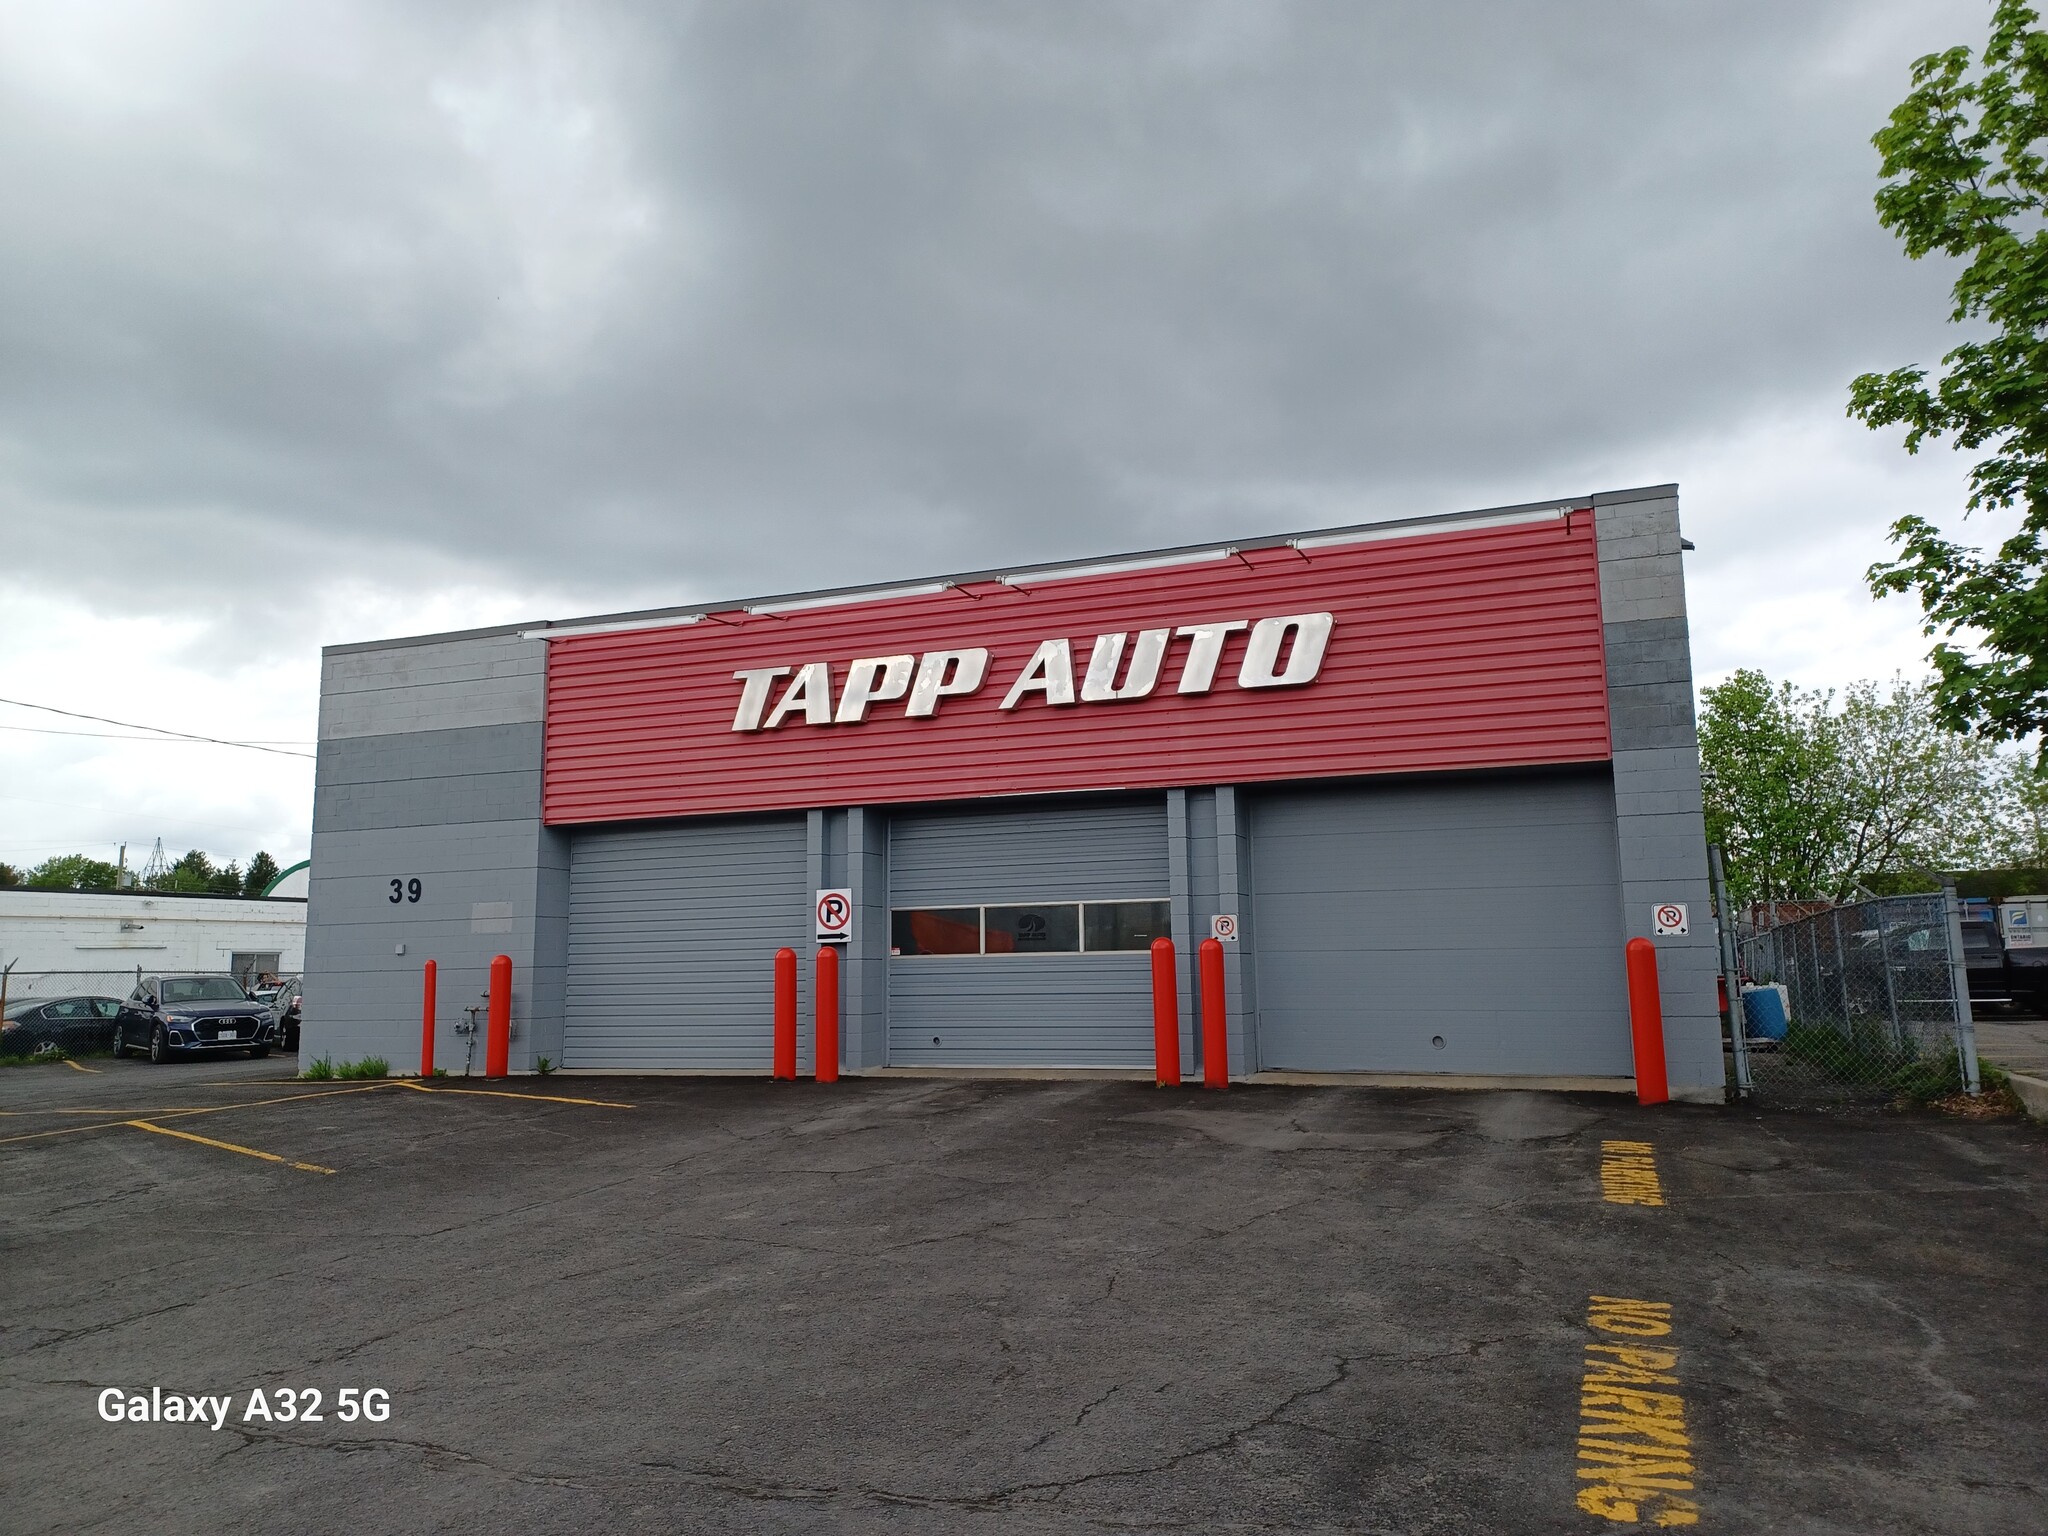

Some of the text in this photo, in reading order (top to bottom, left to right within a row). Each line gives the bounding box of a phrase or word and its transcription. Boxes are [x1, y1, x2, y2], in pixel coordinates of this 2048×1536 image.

[731, 611, 1335, 732] TAPP AUTO
[389, 878, 421, 904] 39
[1576, 1296, 1699, 1527] NO PARKING
